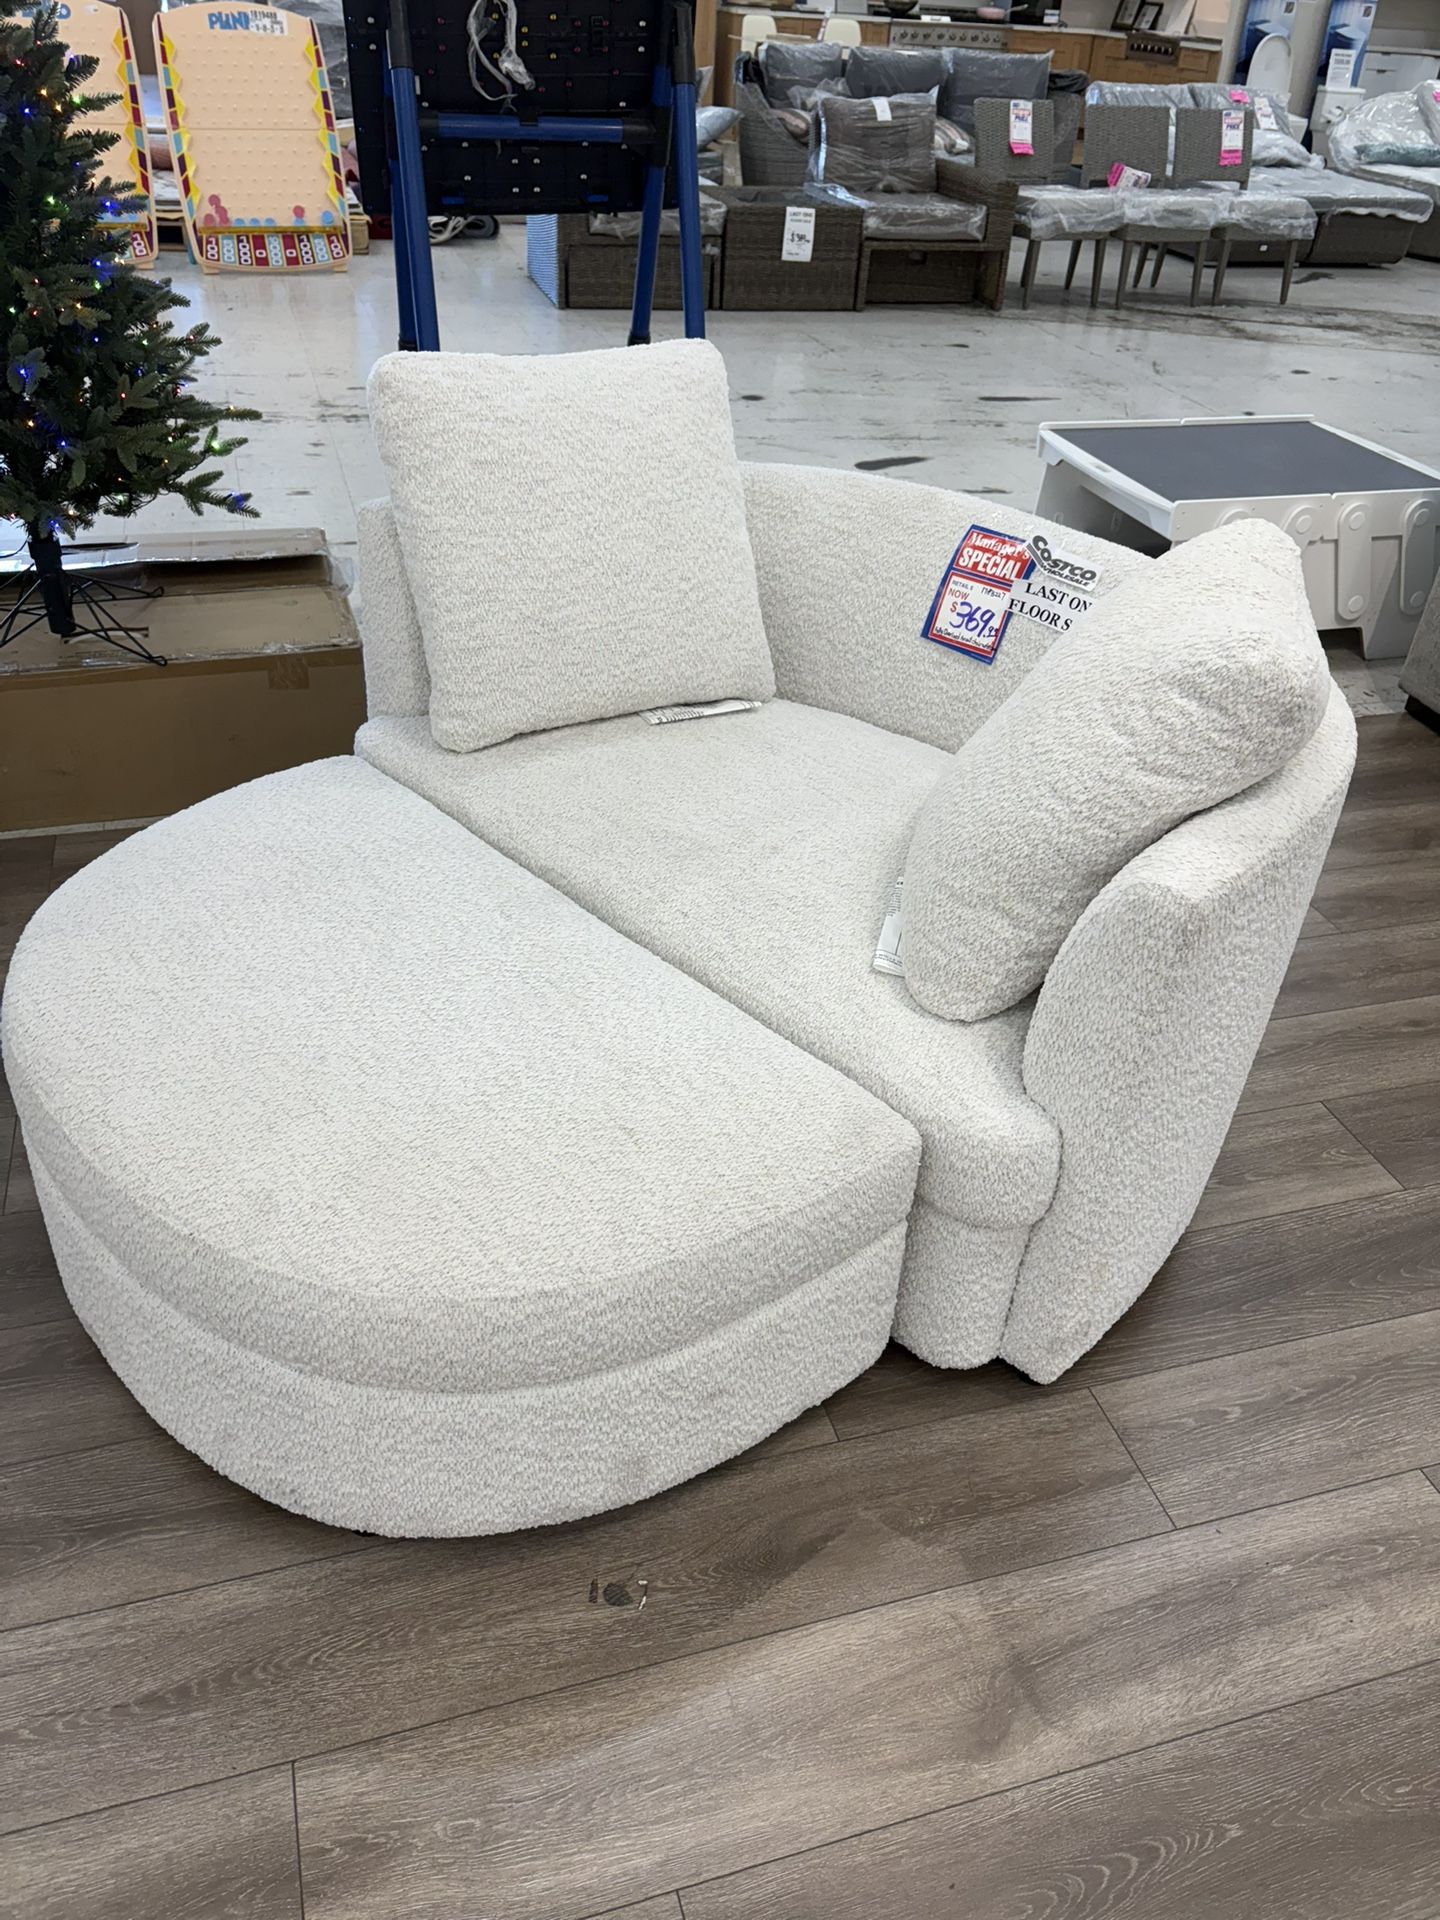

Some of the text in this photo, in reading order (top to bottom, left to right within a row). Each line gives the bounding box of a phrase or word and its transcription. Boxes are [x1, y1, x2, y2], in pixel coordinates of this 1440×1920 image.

[958, 547, 1022, 580] SPECIAL
[1032, 535, 1097, 581] COSTCO
[1041, 563, 1090, 587] WHOLESALE
[948, 588, 970, 601] NOW
[1025, 582, 1069, 605] LAST
[1009, 598, 1061, 628] FLOOR
